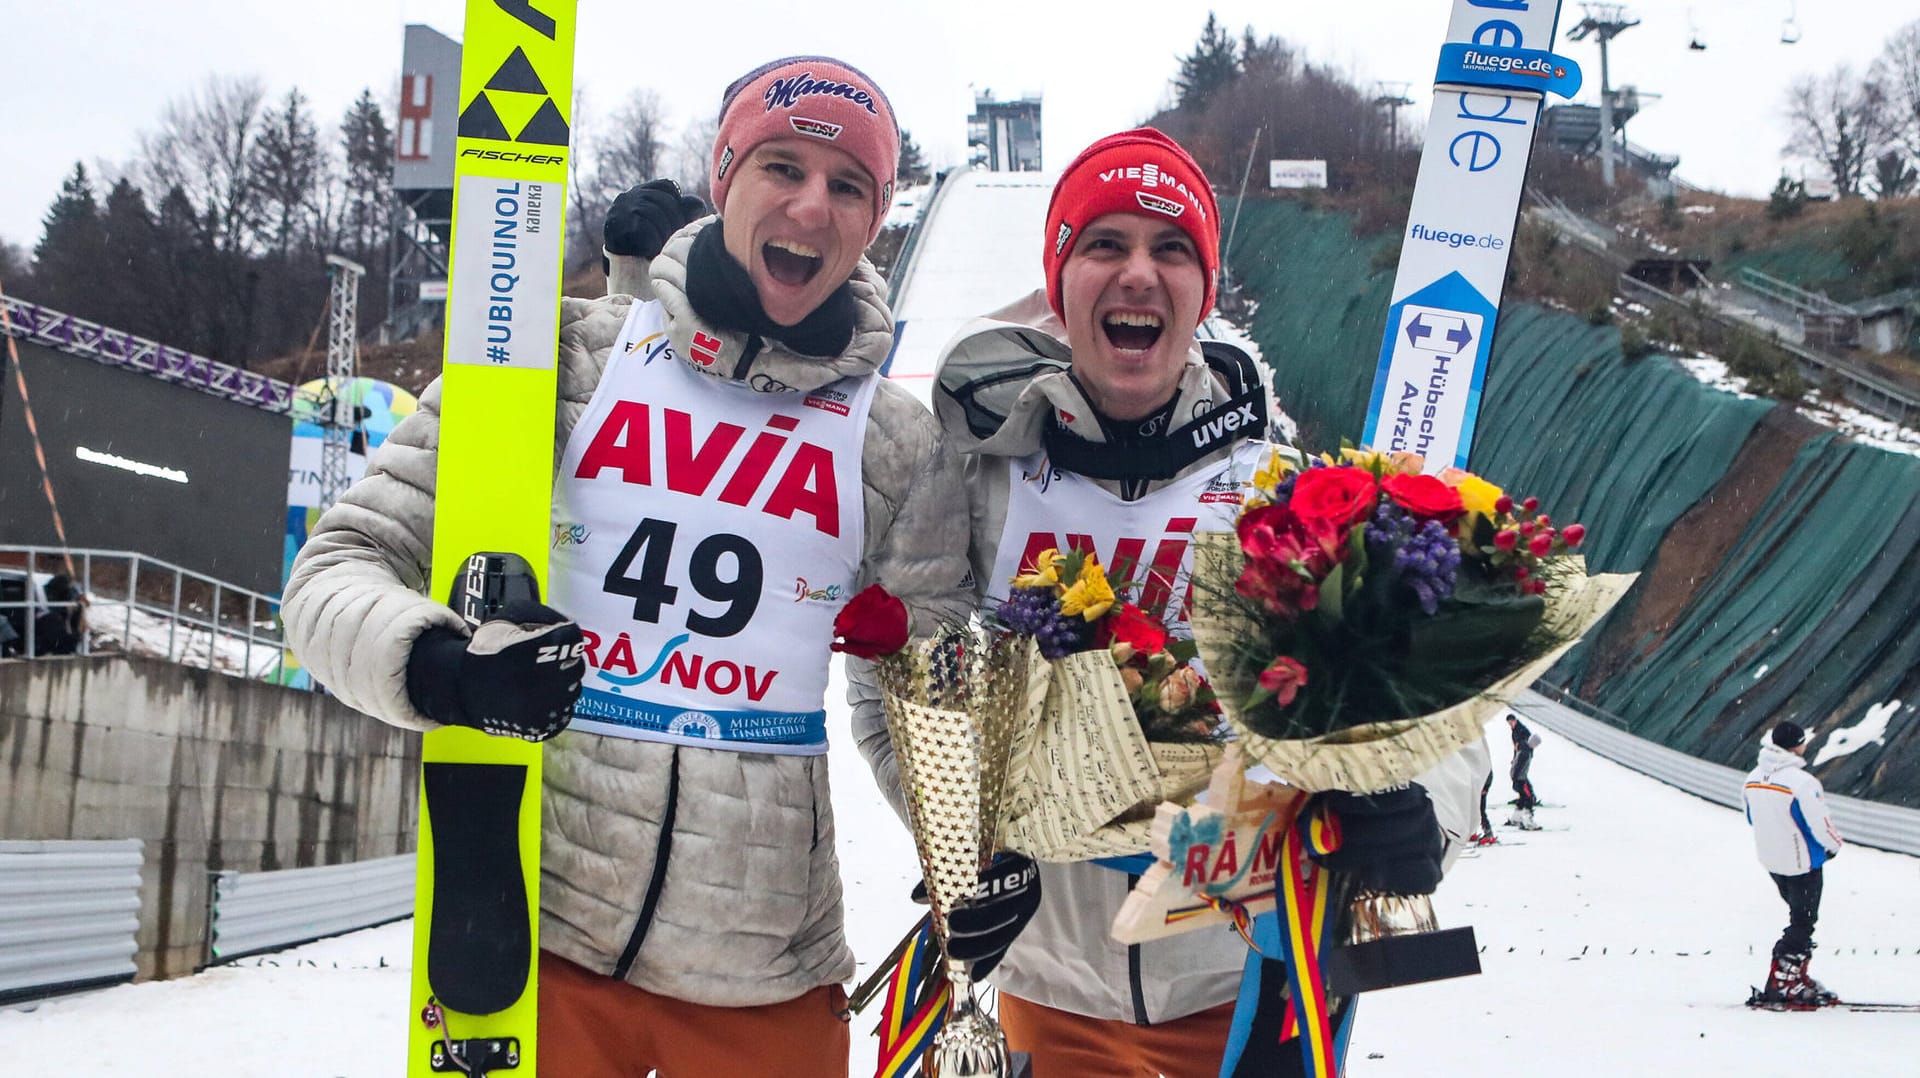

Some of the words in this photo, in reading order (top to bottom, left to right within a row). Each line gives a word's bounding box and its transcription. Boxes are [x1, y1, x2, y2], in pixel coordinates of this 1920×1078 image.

[1463, 50, 1552, 74] fluege.de
[763, 71, 878, 115] Manner
[460, 149, 564, 166] FISCHER
[1099, 163, 1206, 224] VIESSMANN
[1411, 223, 1504, 250] fluege.de
[486, 181, 520, 364] #UBIQUINOL
[1192, 401, 1259, 449] uvex
[1386, 380, 1419, 460] Aufzü
[463, 554, 488, 627] FES
[602, 517, 764, 639] 49
[578, 695, 663, 724] MINISTERUL
[730, 714, 807, 729] MINISTERUL
[484, 726, 549, 743] ziener
[729, 724, 807, 739] TINERETULUI
